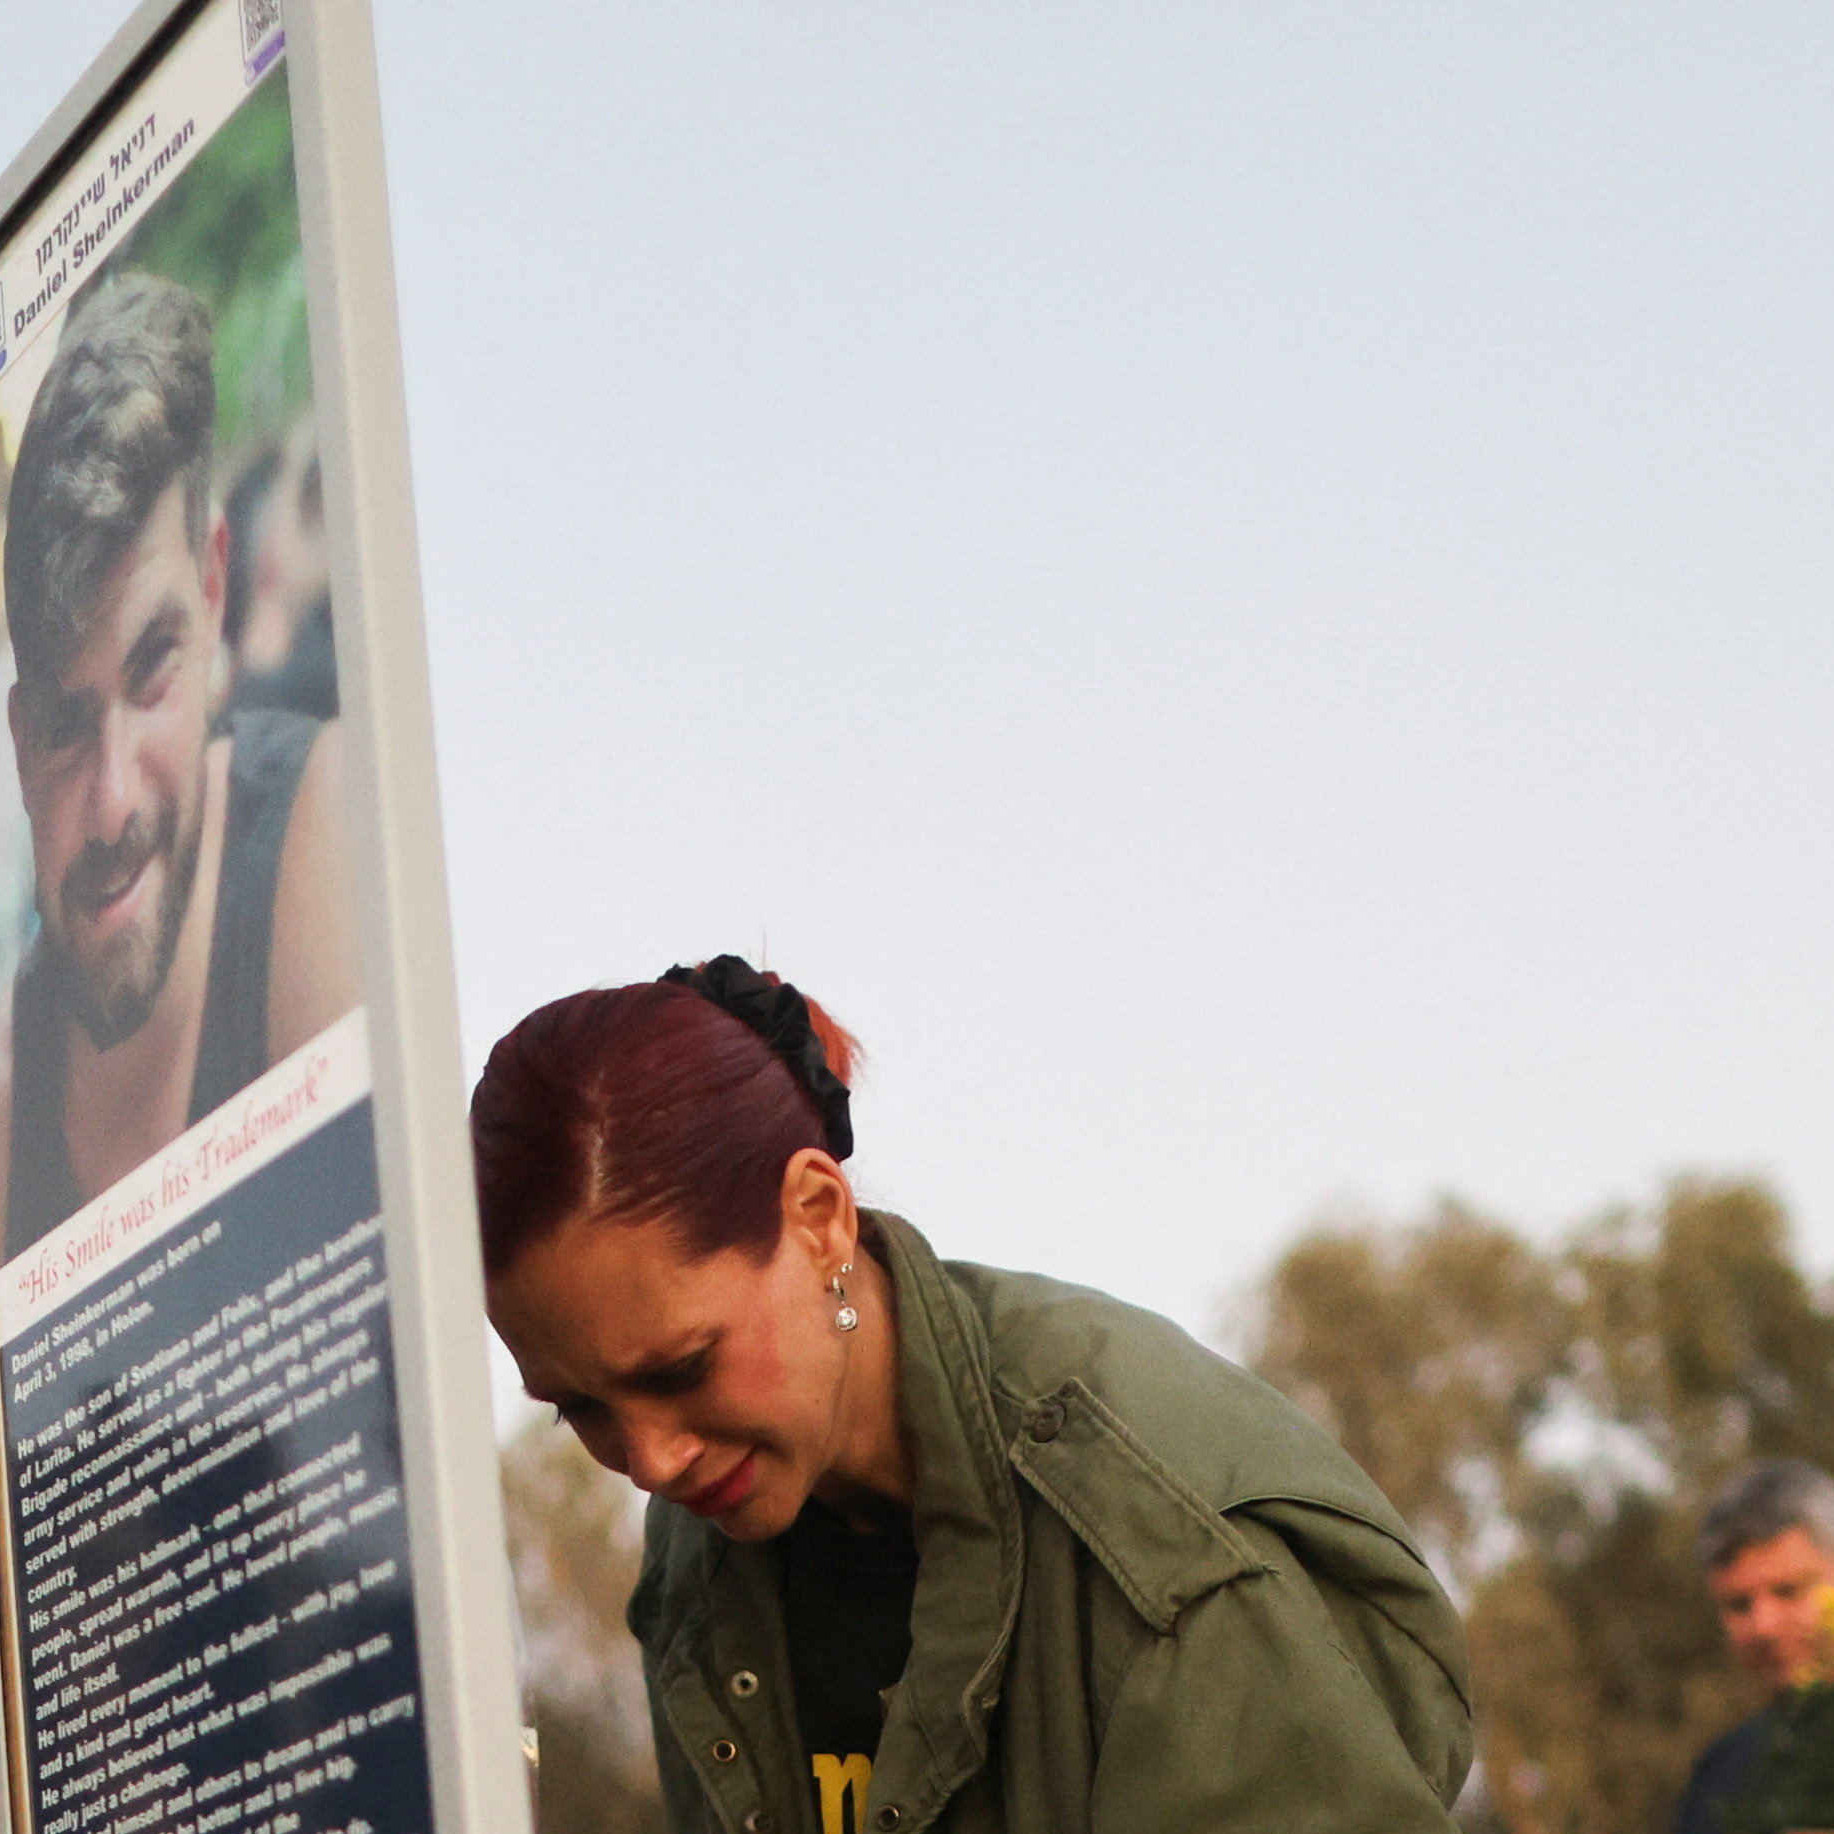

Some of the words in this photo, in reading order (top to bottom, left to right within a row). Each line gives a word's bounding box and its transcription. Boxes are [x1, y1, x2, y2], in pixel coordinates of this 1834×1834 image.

[109, 112, 157, 180] דניאל
[14, 258, 67, 339] Daniel
[73, 118, 195, 269] Sheinkerman
[36, 172, 106, 276] שיינקרמן
[65, 1204, 114, 1277] Smile
[120, 1195, 156, 1235] was
[159, 1159, 190, 1207] his
[12, 1334, 49, 1374] Daniel
[52, 1280, 134, 1346] Sheinkerman
[137, 1260, 165, 1288] was
[167, 1236, 200, 1268] born
[14, 1369, 42, 1403] April
[45, 1362, 56, 1382] 3,
[59, 1337, 94, 1370] 1998,
[96, 1329, 109, 1347] in
[18, 1439, 34, 1459] He
[37, 1421, 62, 1446] was
[65, 1406, 85, 1429] the
[88, 1390, 112, 1414] son
[115, 1373, 127, 1396] of
[20, 1465, 31, 1488] of
[77, 1430, 95, 1452] He
[98, 1397, 142, 1439] served
[145, 1389, 161, 1410] as
[165, 1381, 174, 1397] a
[22, 1478, 68, 1517] Brigade
[71, 1414, 172, 1486] reconnaissance
[175, 1392, 203, 1422] unit
[24, 1517, 54, 1546] army
[57, 1488, 103, 1525] service
[106, 1466, 130, 1496] and
[133, 1448, 170, 1479] while
[173, 1438, 186, 1456] in
[189, 1422, 212, 1445] the
[26, 1535, 66, 1574] served
[69, 1520, 97, 1548] with
[100, 1485, 159, 1531] strength,
[28, 1566, 77, 1603] country.
[30, 1610, 50, 1632] His
[52, 1590, 86, 1620] smile
[89, 1575, 115, 1599] was
[117, 1561, 137, 1583] his
[140, 1524, 200, 1570] hallmark
[32, 1628, 76, 1666] people,
[79, 1597, 123, 1637] spread
[125, 1570, 181, 1610] warmth,
[184, 1549, 210, 1579] and
[33, 1661, 67, 1690] went.
[70, 1635, 110, 1671] Daniel
[113, 1624, 140, 1648] was
[143, 1618, 152, 1633] a
[154, 1602, 183, 1626] free
[36, 1693, 58, 1720] and
[61, 1685, 81, 1707] life
[84, 1662, 119, 1695] itself.
[38, 1729, 55, 1749] He
[58, 1710, 87, 1739] lived
[90, 1694, 125, 1723] every
[128, 1663, 183, 1704] moment
[186, 1657, 201, 1675] to
[204, 1644, 228, 1666] the
[40, 1752, 62, 1779] and
[66, 1752, 73, 1767] a
[76, 1732, 104, 1761] kind
[107, 1719, 131, 1747] and
[134, 1702, 170, 1738] great
[42, 1788, 59, 1809] He
[62, 1768, 106, 1799] always
[108, 1735, 164, 1777] believed
[166, 1722, 195, 1750] that
[197, 1704, 234, 1735] what
[82, 1796, 106, 1826] just
[109, 1794, 118, 1809] a
[121, 1763, 189, 1803] challenge.
[167, 1787, 193, 1815] and
[195, 1770, 242, 1802] others
[198, 1803, 241, 1834] better
